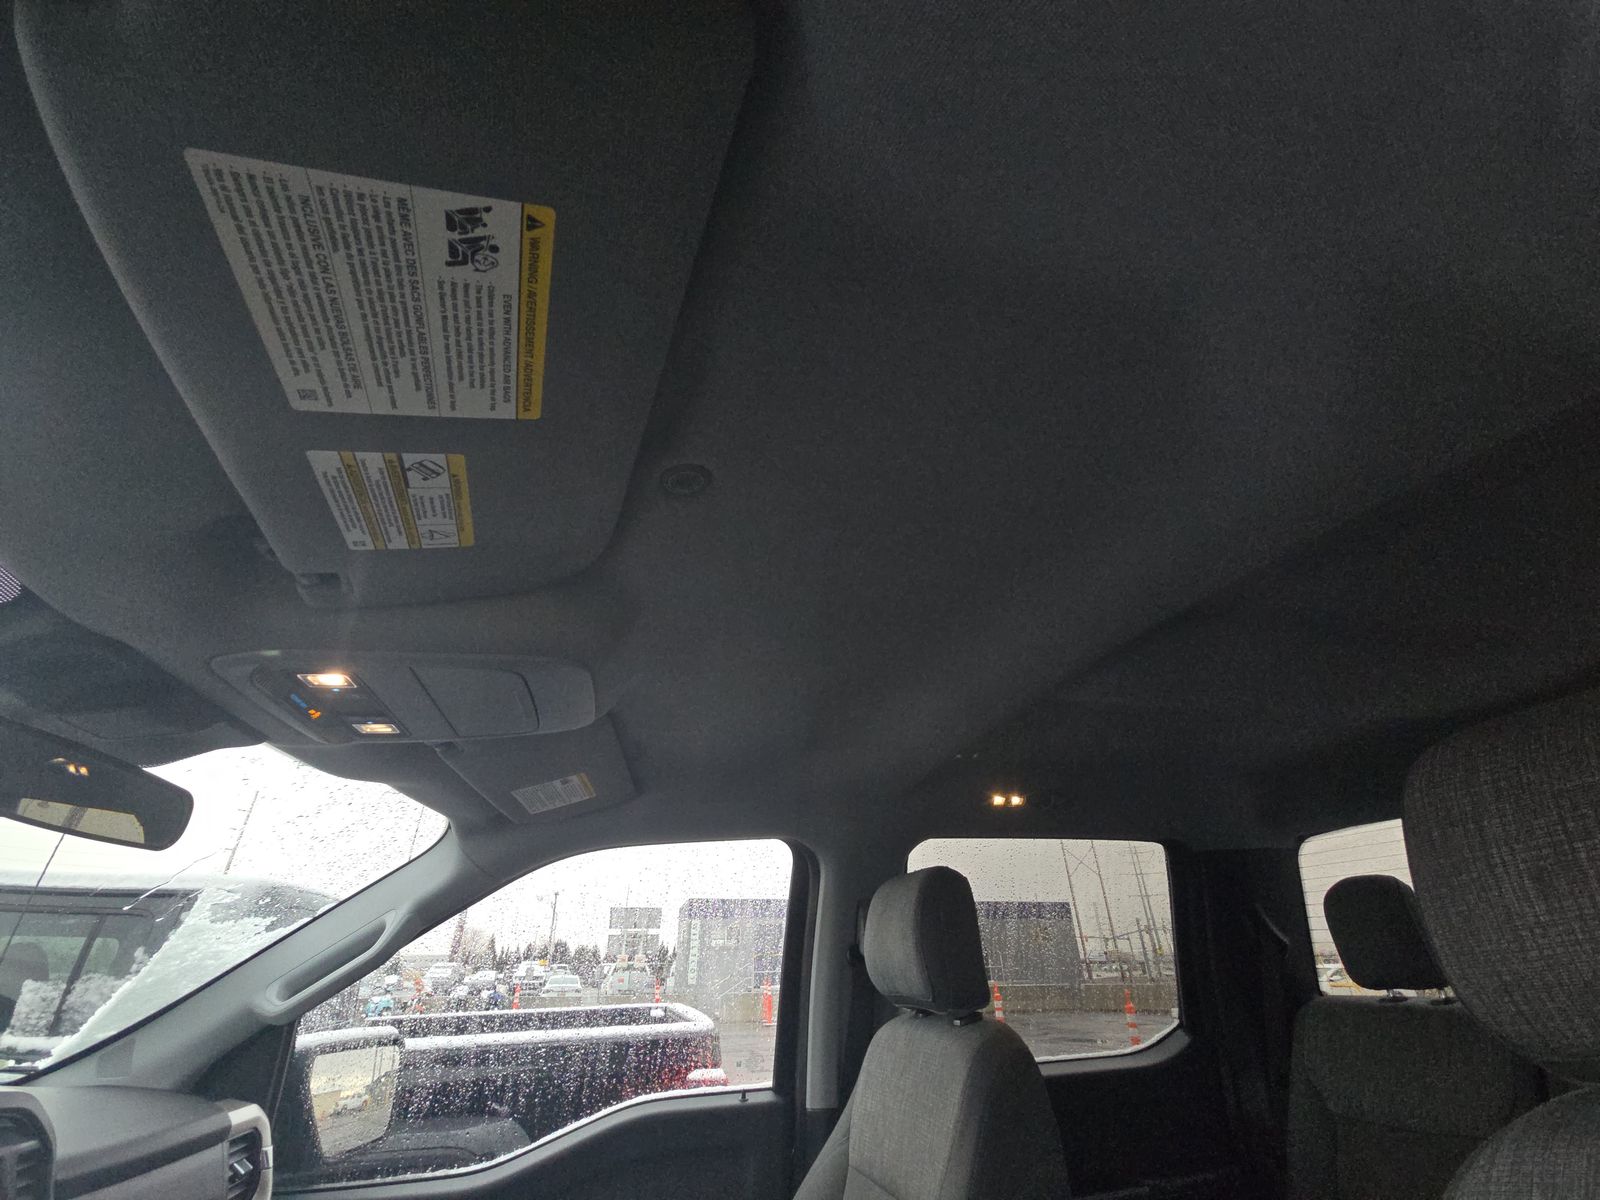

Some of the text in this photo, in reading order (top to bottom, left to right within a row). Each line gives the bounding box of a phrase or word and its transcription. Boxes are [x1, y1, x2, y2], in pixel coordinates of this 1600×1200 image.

[296, 193, 325, 251] INCLUSIVE
[395, 196, 414, 229] MÊME
[400, 228, 415, 256] AVEC
[313, 252, 331, 274] CON
[404, 257, 418, 277] DES
[527, 236, 540, 284] WARNING
[320, 275, 337, 295] LAS
[407, 278, 422, 303] SACS
[326, 296, 346, 330] NUEVAS
[502, 293, 512, 315] EVEN
[411, 303, 429, 355] GONFLABLES
[502, 316, 511, 336] WITH
[524, 288, 537, 359] AVERTISSEMENT
[336, 330, 355, 362] BOLSAS
[502, 336, 511, 373] ADVANCED
[346, 362, 358, 373] DE
[349, 373, 363, 389] AIRE
[502, 385, 511, 403] BAGS
[522, 363, 533, 413] ADVERTENCIA
